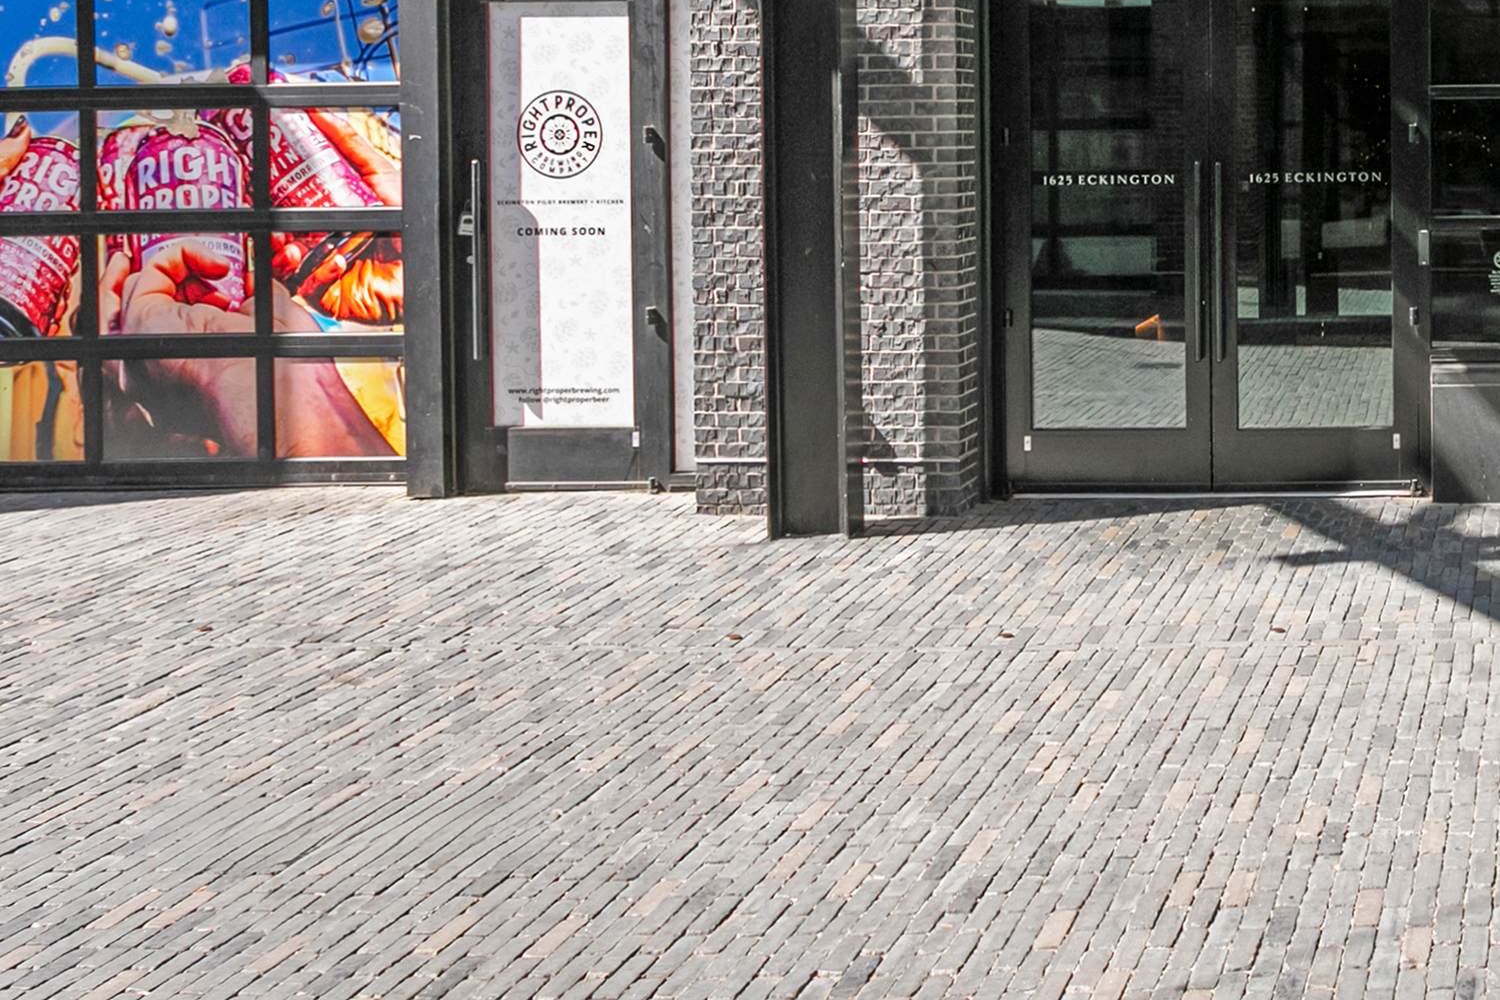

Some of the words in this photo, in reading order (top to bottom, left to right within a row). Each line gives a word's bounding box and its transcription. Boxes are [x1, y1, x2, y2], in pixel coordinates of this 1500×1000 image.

[521, 98, 549, 152] RIGHT
[555, 95, 597, 151] PROPER
[531, 157, 588, 174] COMPANY
[11, 152, 80, 196] RIG
[1043, 175, 1073, 186] 1625
[1078, 174, 1175, 185] ECKINGTON
[1249, 173, 1279, 183] 1625
[1284, 172, 1382, 183] ECKINGTON
[517, 227, 567, 236] COMING
[571, 227, 606, 236] SOON
